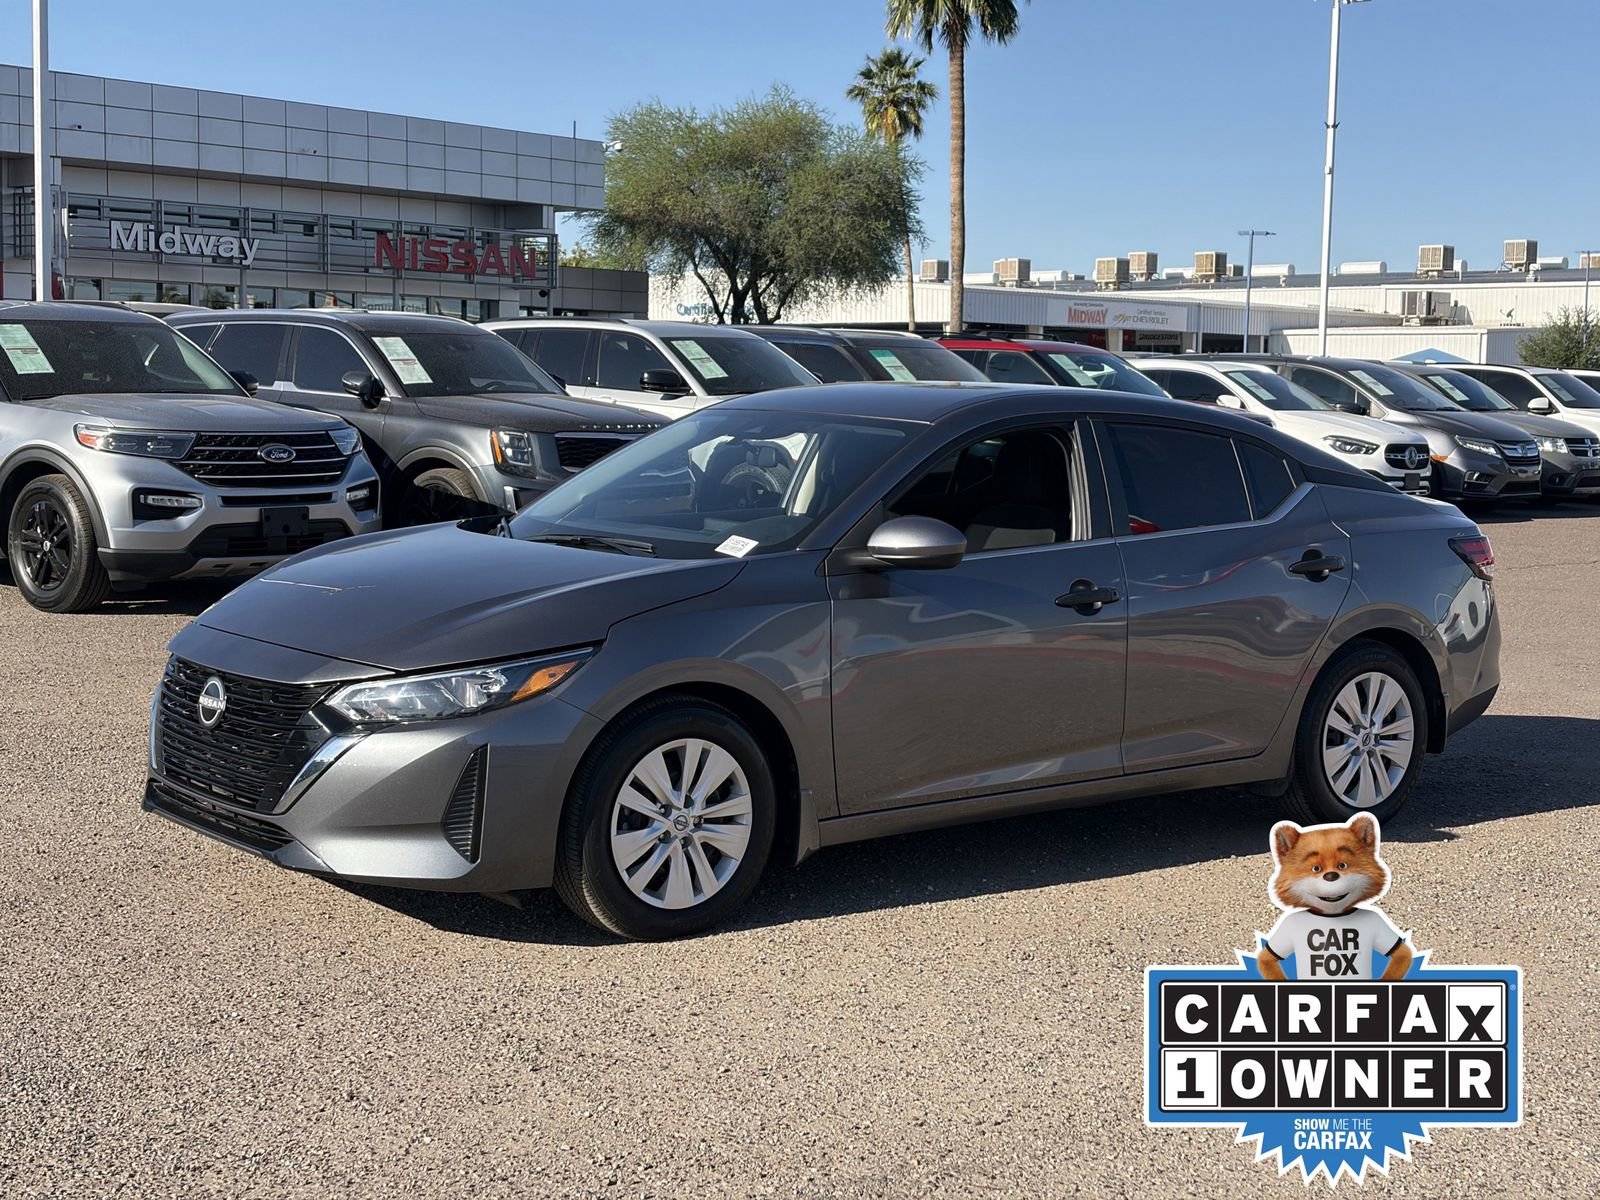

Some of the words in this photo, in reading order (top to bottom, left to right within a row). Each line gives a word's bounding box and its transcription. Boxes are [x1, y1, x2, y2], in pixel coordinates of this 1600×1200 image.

[109, 220, 260, 265] Midway
[376, 232, 536, 277] NISSAN
[1067, 307, 1109, 325] MIDWAY
[1132, 315, 1169, 325] CHEVROLET
[270, 449, 288, 458] Ford
